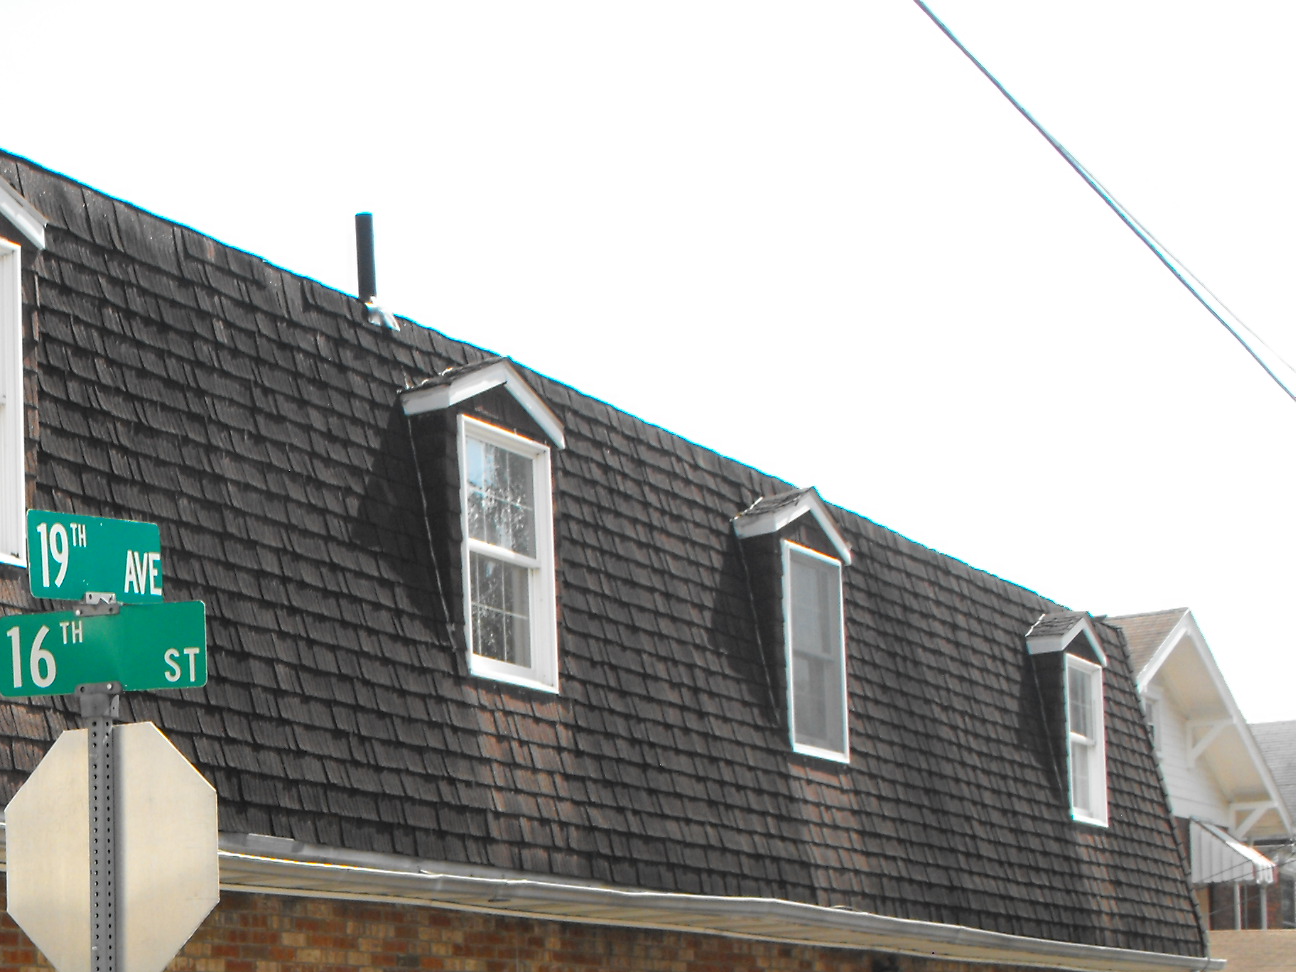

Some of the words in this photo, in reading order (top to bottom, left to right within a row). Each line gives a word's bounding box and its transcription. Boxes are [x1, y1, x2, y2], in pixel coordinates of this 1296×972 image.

[35, 521, 87, 588] 19TH
[123, 549, 163, 597] AVE
[6, 619, 84, 689] 16TH
[163, 646, 201, 683] ST
